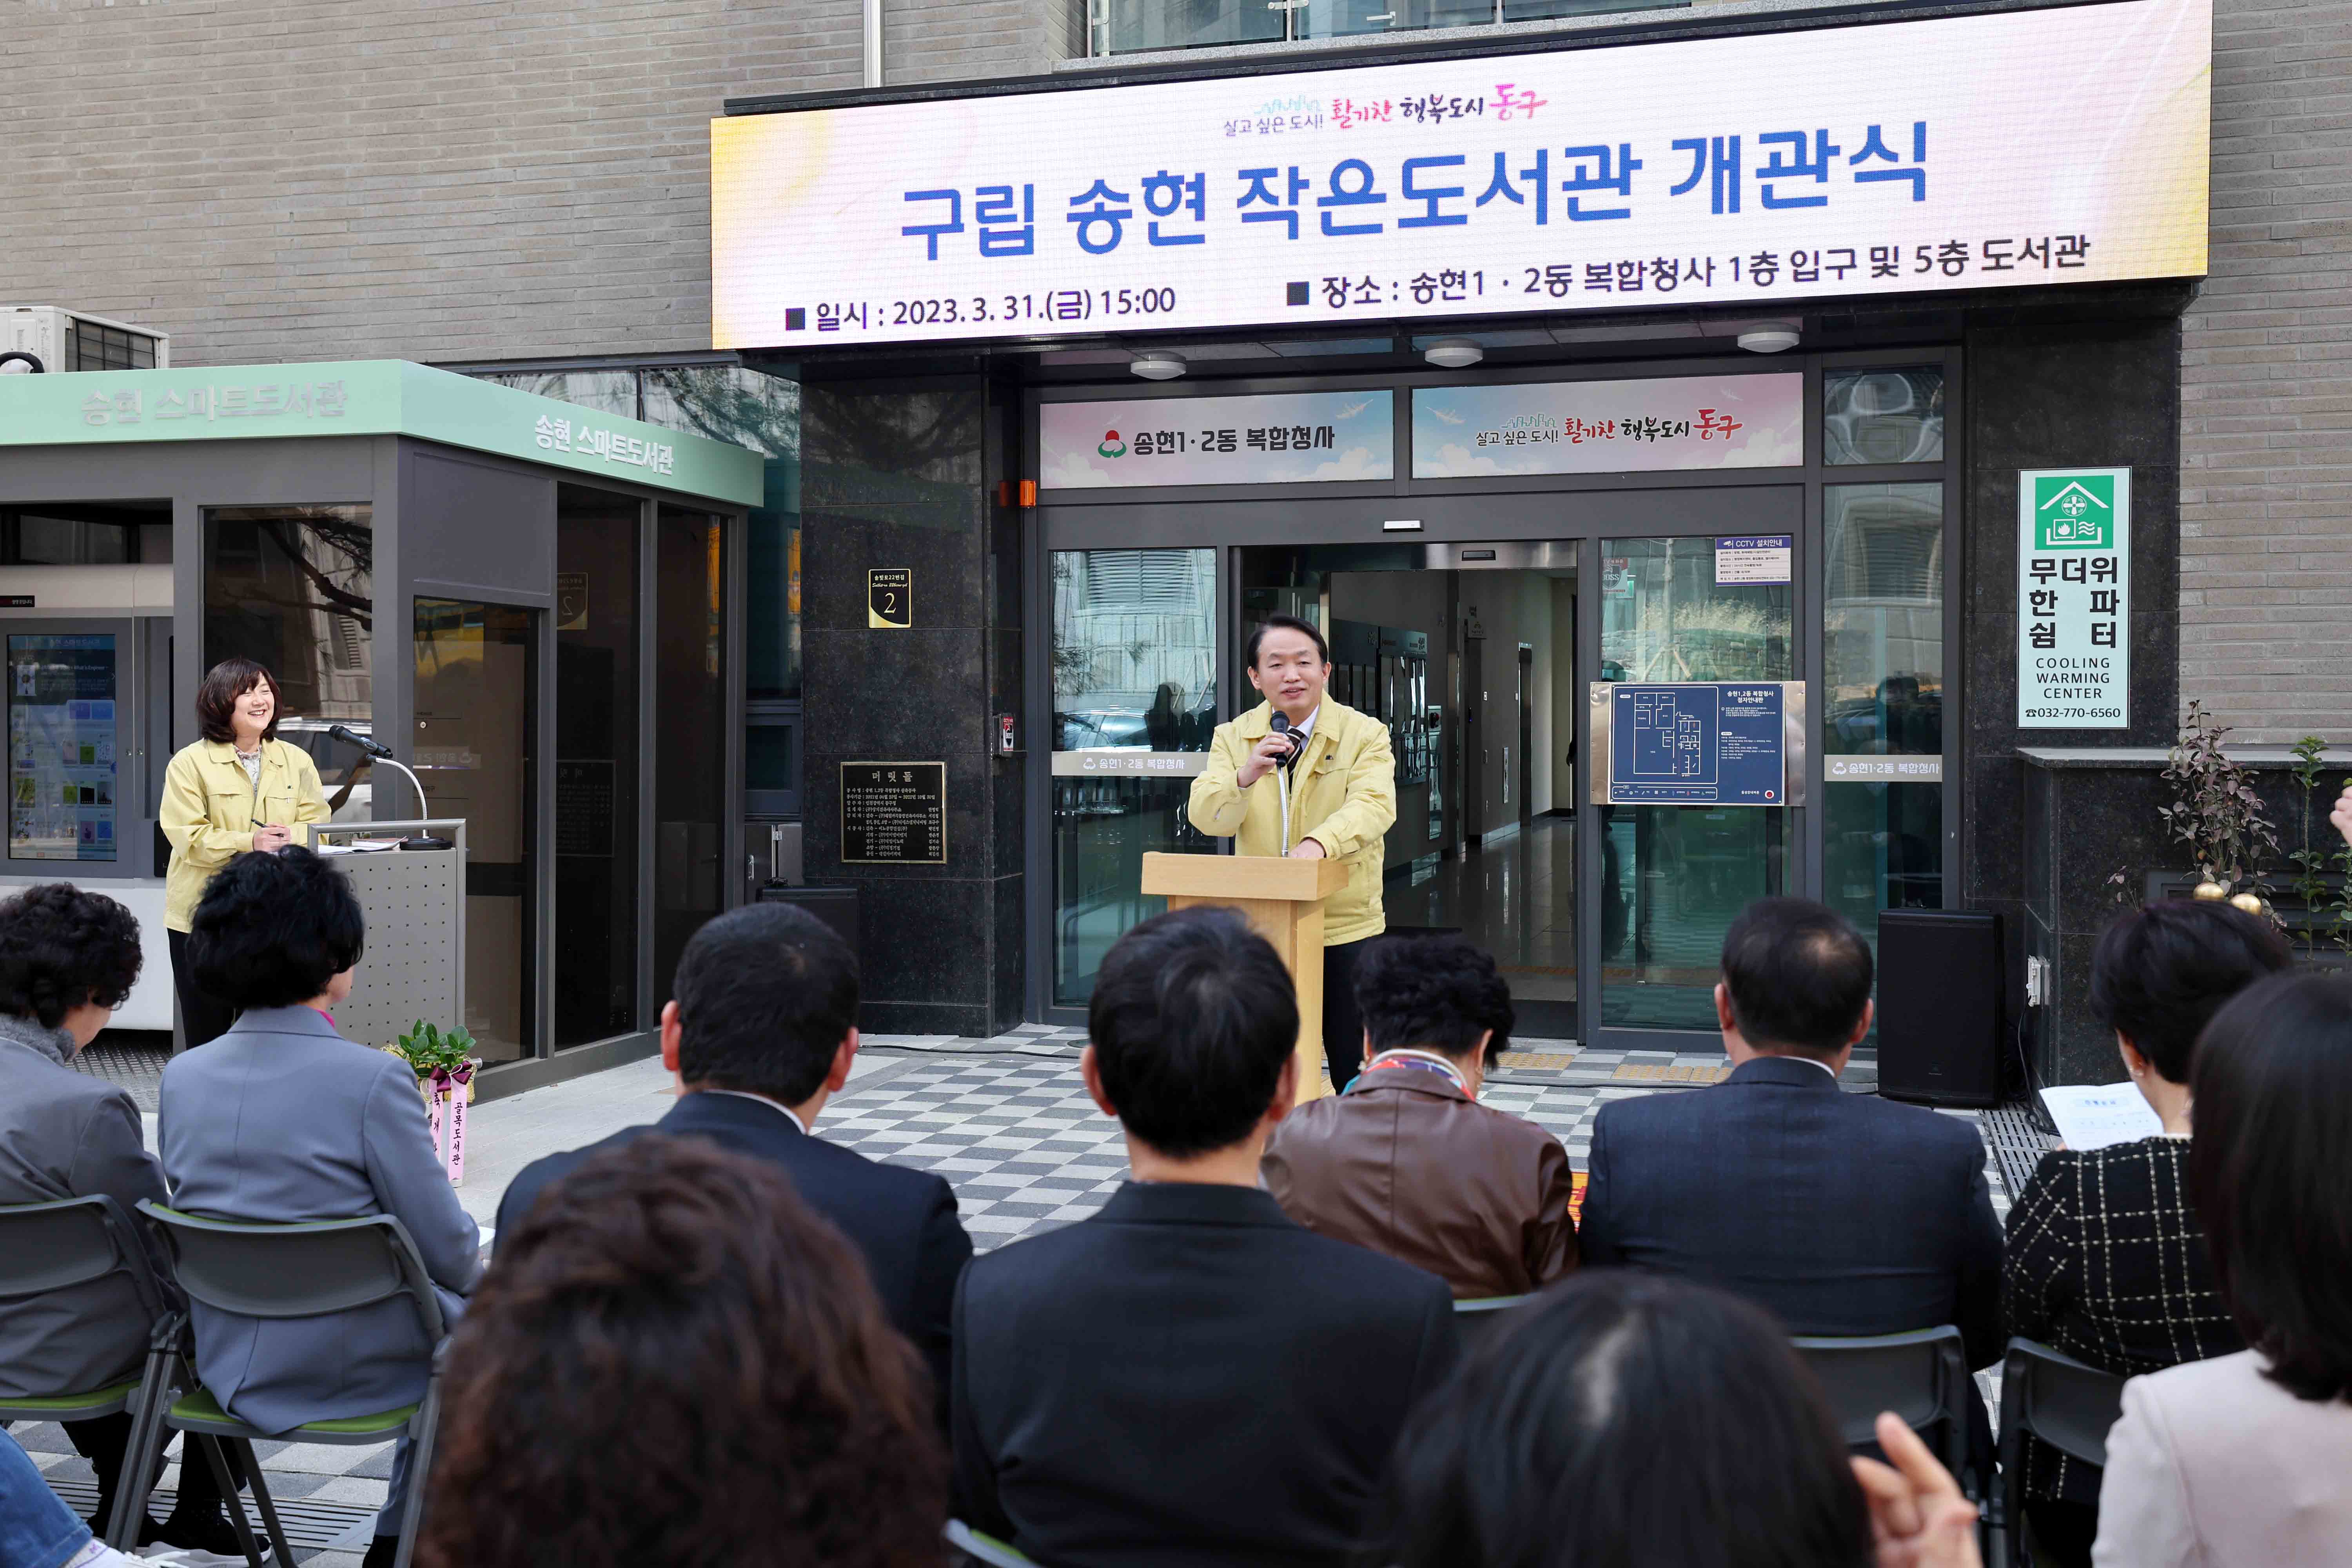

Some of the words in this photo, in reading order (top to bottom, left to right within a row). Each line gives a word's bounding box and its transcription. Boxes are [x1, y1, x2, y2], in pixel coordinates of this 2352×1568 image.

[1224, 119, 1251, 137] 살고
[1256, 116, 1285, 134] 싶은
[1290, 108, 1323, 130] 도시!
[1331, 98, 1393, 129] 활기찬
[1399, 93, 1484, 125] 행복도시
[1489, 83, 1548, 122] 동구
[902, 184, 1034, 260] 구립
[1066, 170, 1205, 255] 송현
[1237, 129, 1643, 240] 작은도서관
[1670, 122, 1926, 214] 개관식
[1322, 276, 1382, 309] 장소
[1584, 256, 1716, 292] 복합청사
[1730, 251, 1780, 287] 1층
[1790, 248, 1857, 283] 입구
[1870, 245, 1899, 278] 및
[1915, 239, 1970, 277] 5층
[1981, 234, 2091, 271] 도서관
[817, 302, 867, 332] 일시
[1101, 287, 1176, 314] 15:00
[81, 388, 142, 426] 송현
[154, 379, 348, 422] 스마트도서관
[1134, 429, 1238, 456] 송현1·2동
[1246, 425, 1335, 451] 복합청사
[1476, 432, 1501, 446] 살고
[1503, 431, 1528, 445] 싶은
[1530, 429, 1559, 443] 도시!
[1563, 417, 1615, 444] 활기찬
[1621, 416, 1690, 443] 행복도시
[1693, 408, 1743, 440] 동구
[535, 414, 571, 453] 송현
[576, 426, 674, 475] 스마트도서관
[2029, 557, 2118, 584] 무더위
[884, 592, 897, 614] 2
[2036, 657, 2110, 668] COOLING
[2036, 673, 2110, 684] WARMING
[2043, 688, 2102, 699] CENTER
[2037, 708, 2120, 718] 032-770-6560
[1099, 758, 1144, 769] 송현1·2동
[1147, 757, 1185, 769] 복합청사
[1849, 762, 1895, 774] 송현1·2동
[1898, 762, 1940, 774] 복합청사
[452, 1102, 463, 1165] 골목도서관
